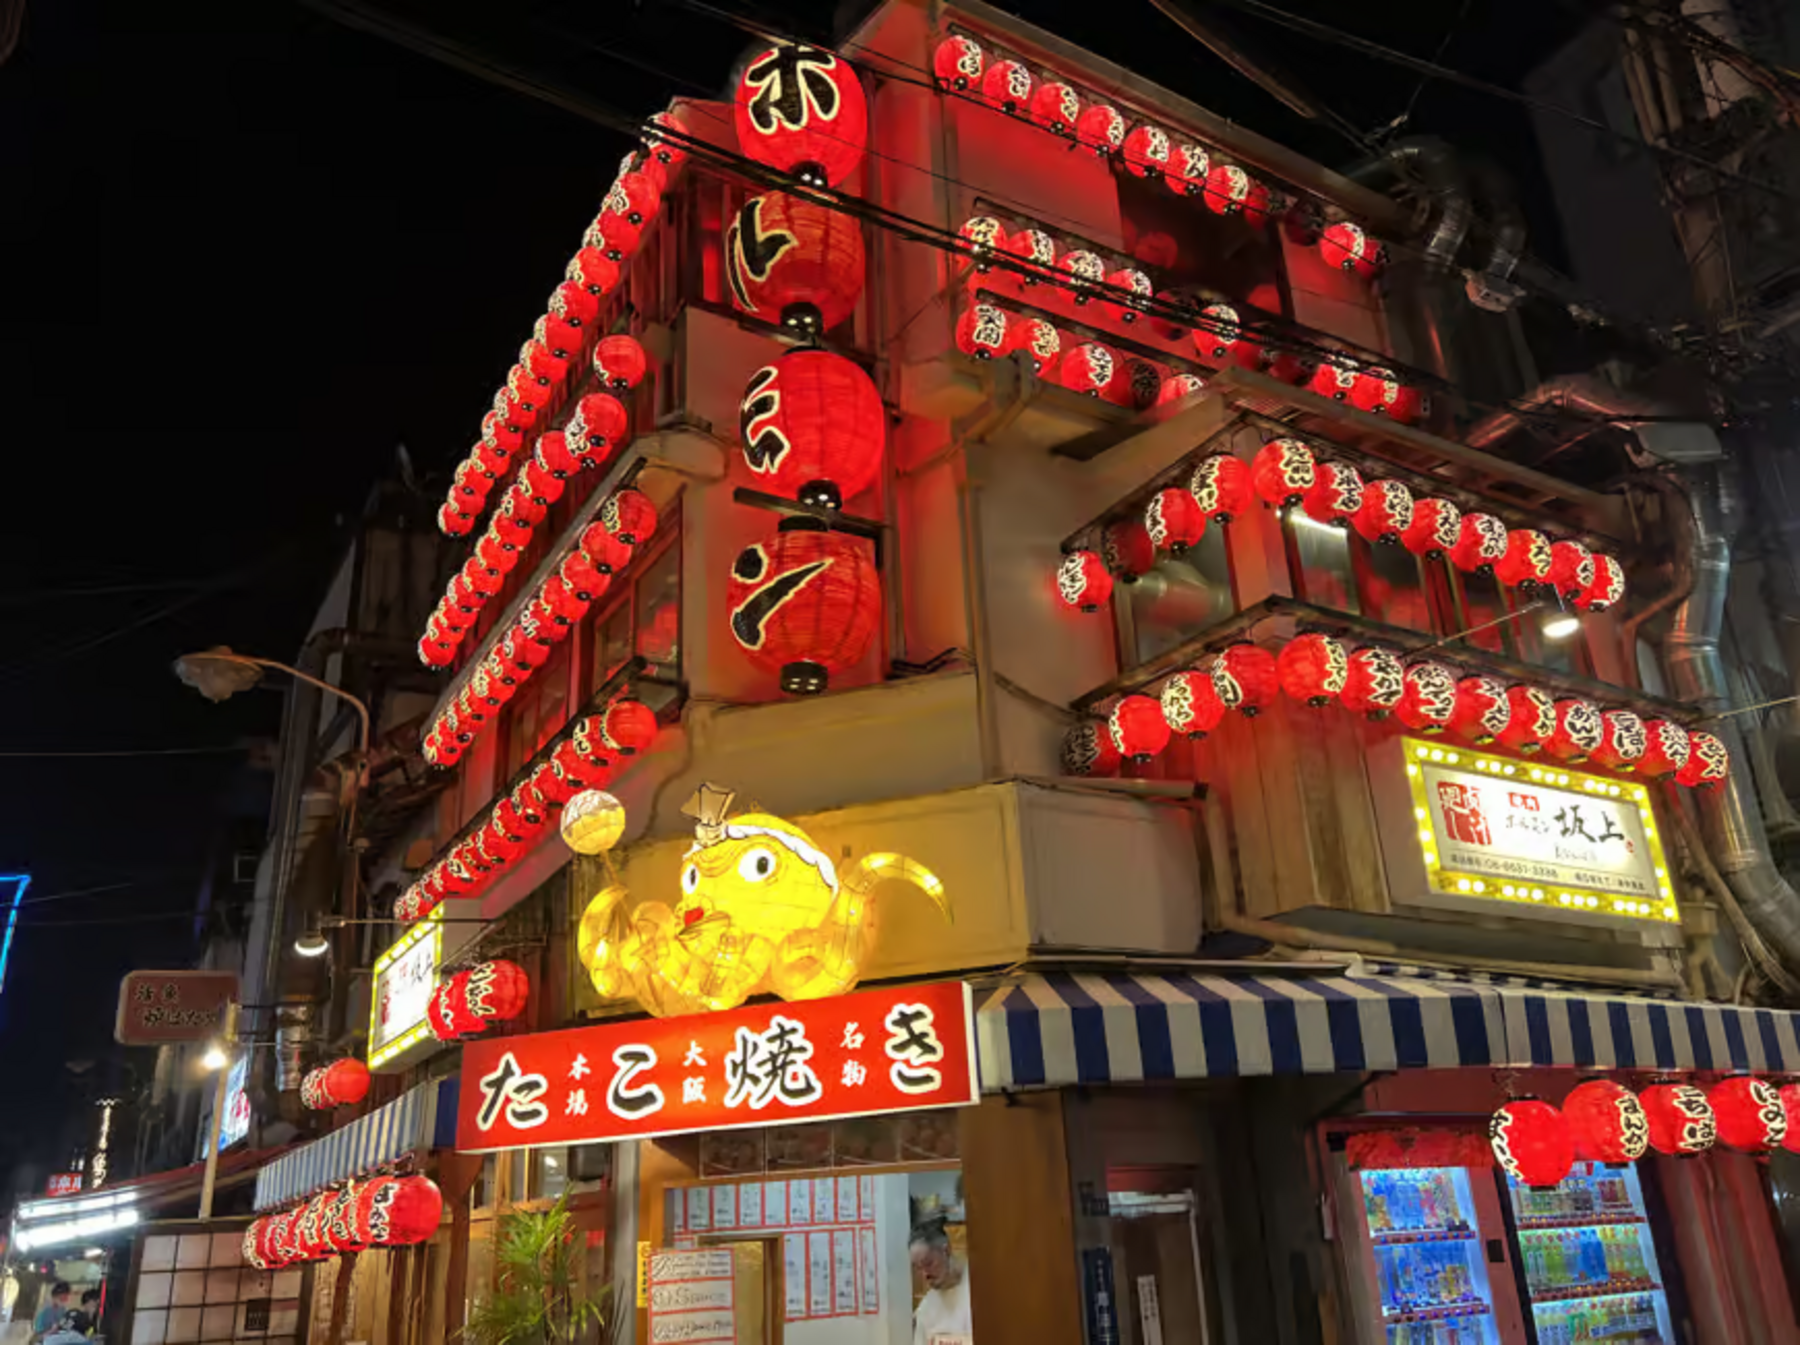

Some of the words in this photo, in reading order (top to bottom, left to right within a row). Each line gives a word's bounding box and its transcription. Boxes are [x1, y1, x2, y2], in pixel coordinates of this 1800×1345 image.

[1553, 803, 1625, 843] 坂上
[476, 1002, 944, 1132] たこ焼き
[564, 1053, 591, 1117] 本場
[682, 1040, 708, 1105] 大阪
[840, 1021, 867, 1087] 名物
